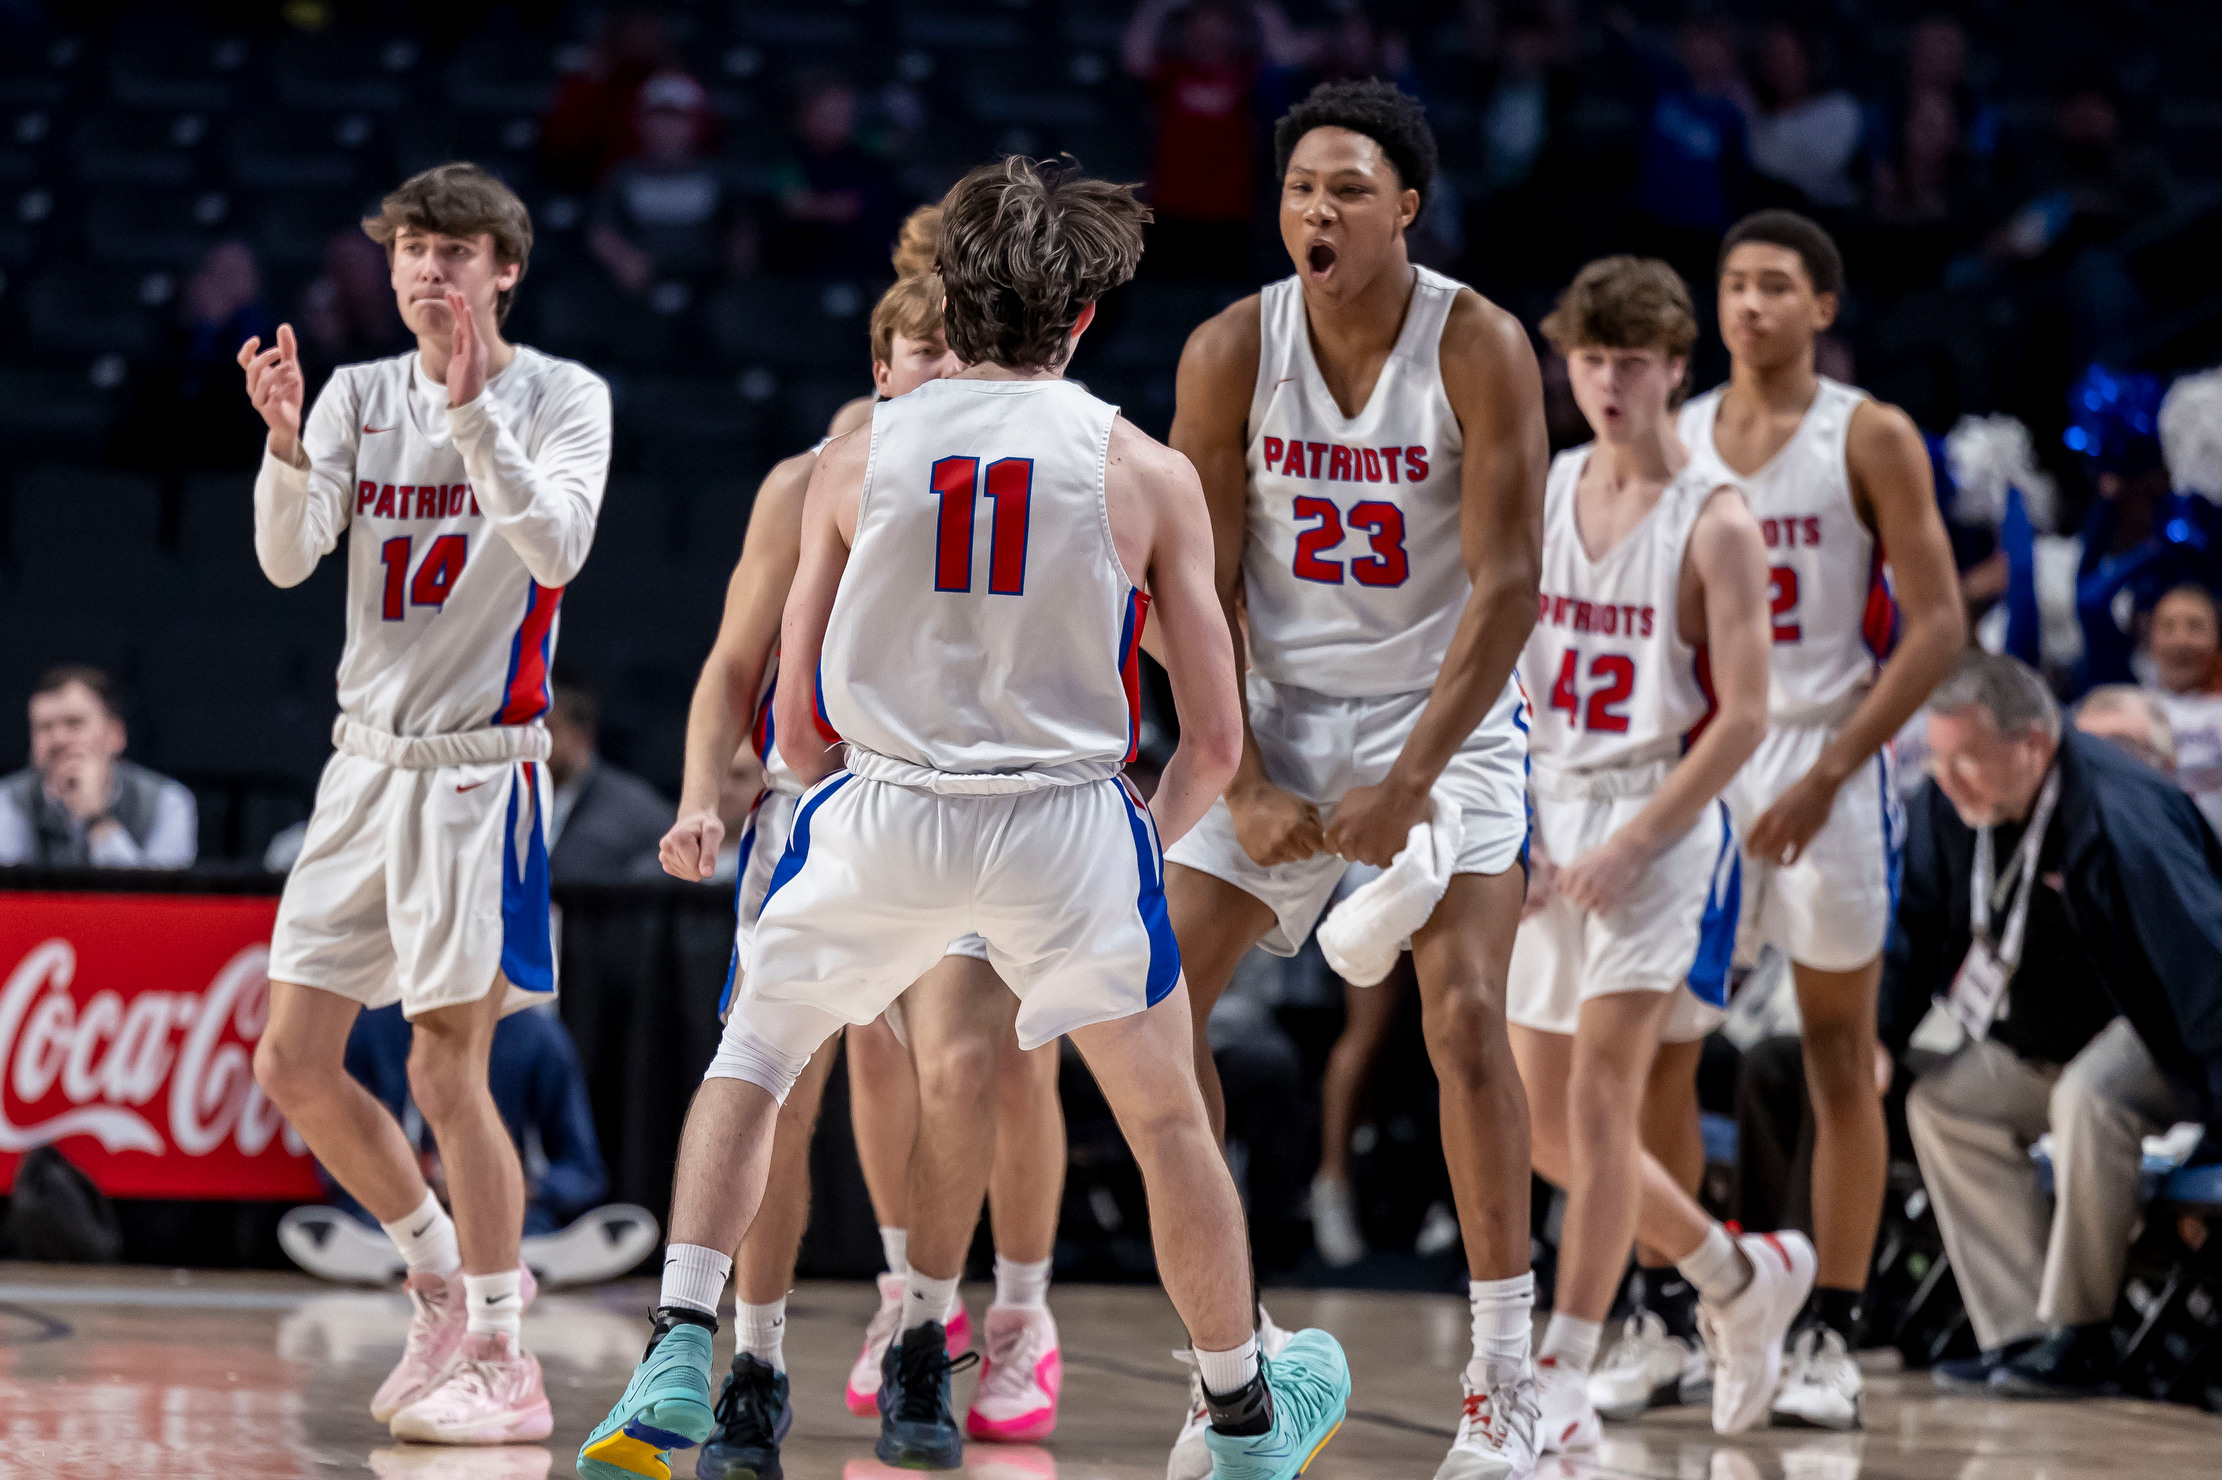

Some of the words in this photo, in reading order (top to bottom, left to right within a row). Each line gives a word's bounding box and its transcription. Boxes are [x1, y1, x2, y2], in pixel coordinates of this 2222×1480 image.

[1263, 435, 1430, 484] PATRIOTS
[929, 454, 1035, 597] 11
[1292, 494, 1410, 589] 23
[380, 533, 469, 622] 14
[1549, 648, 1636, 735] 42
